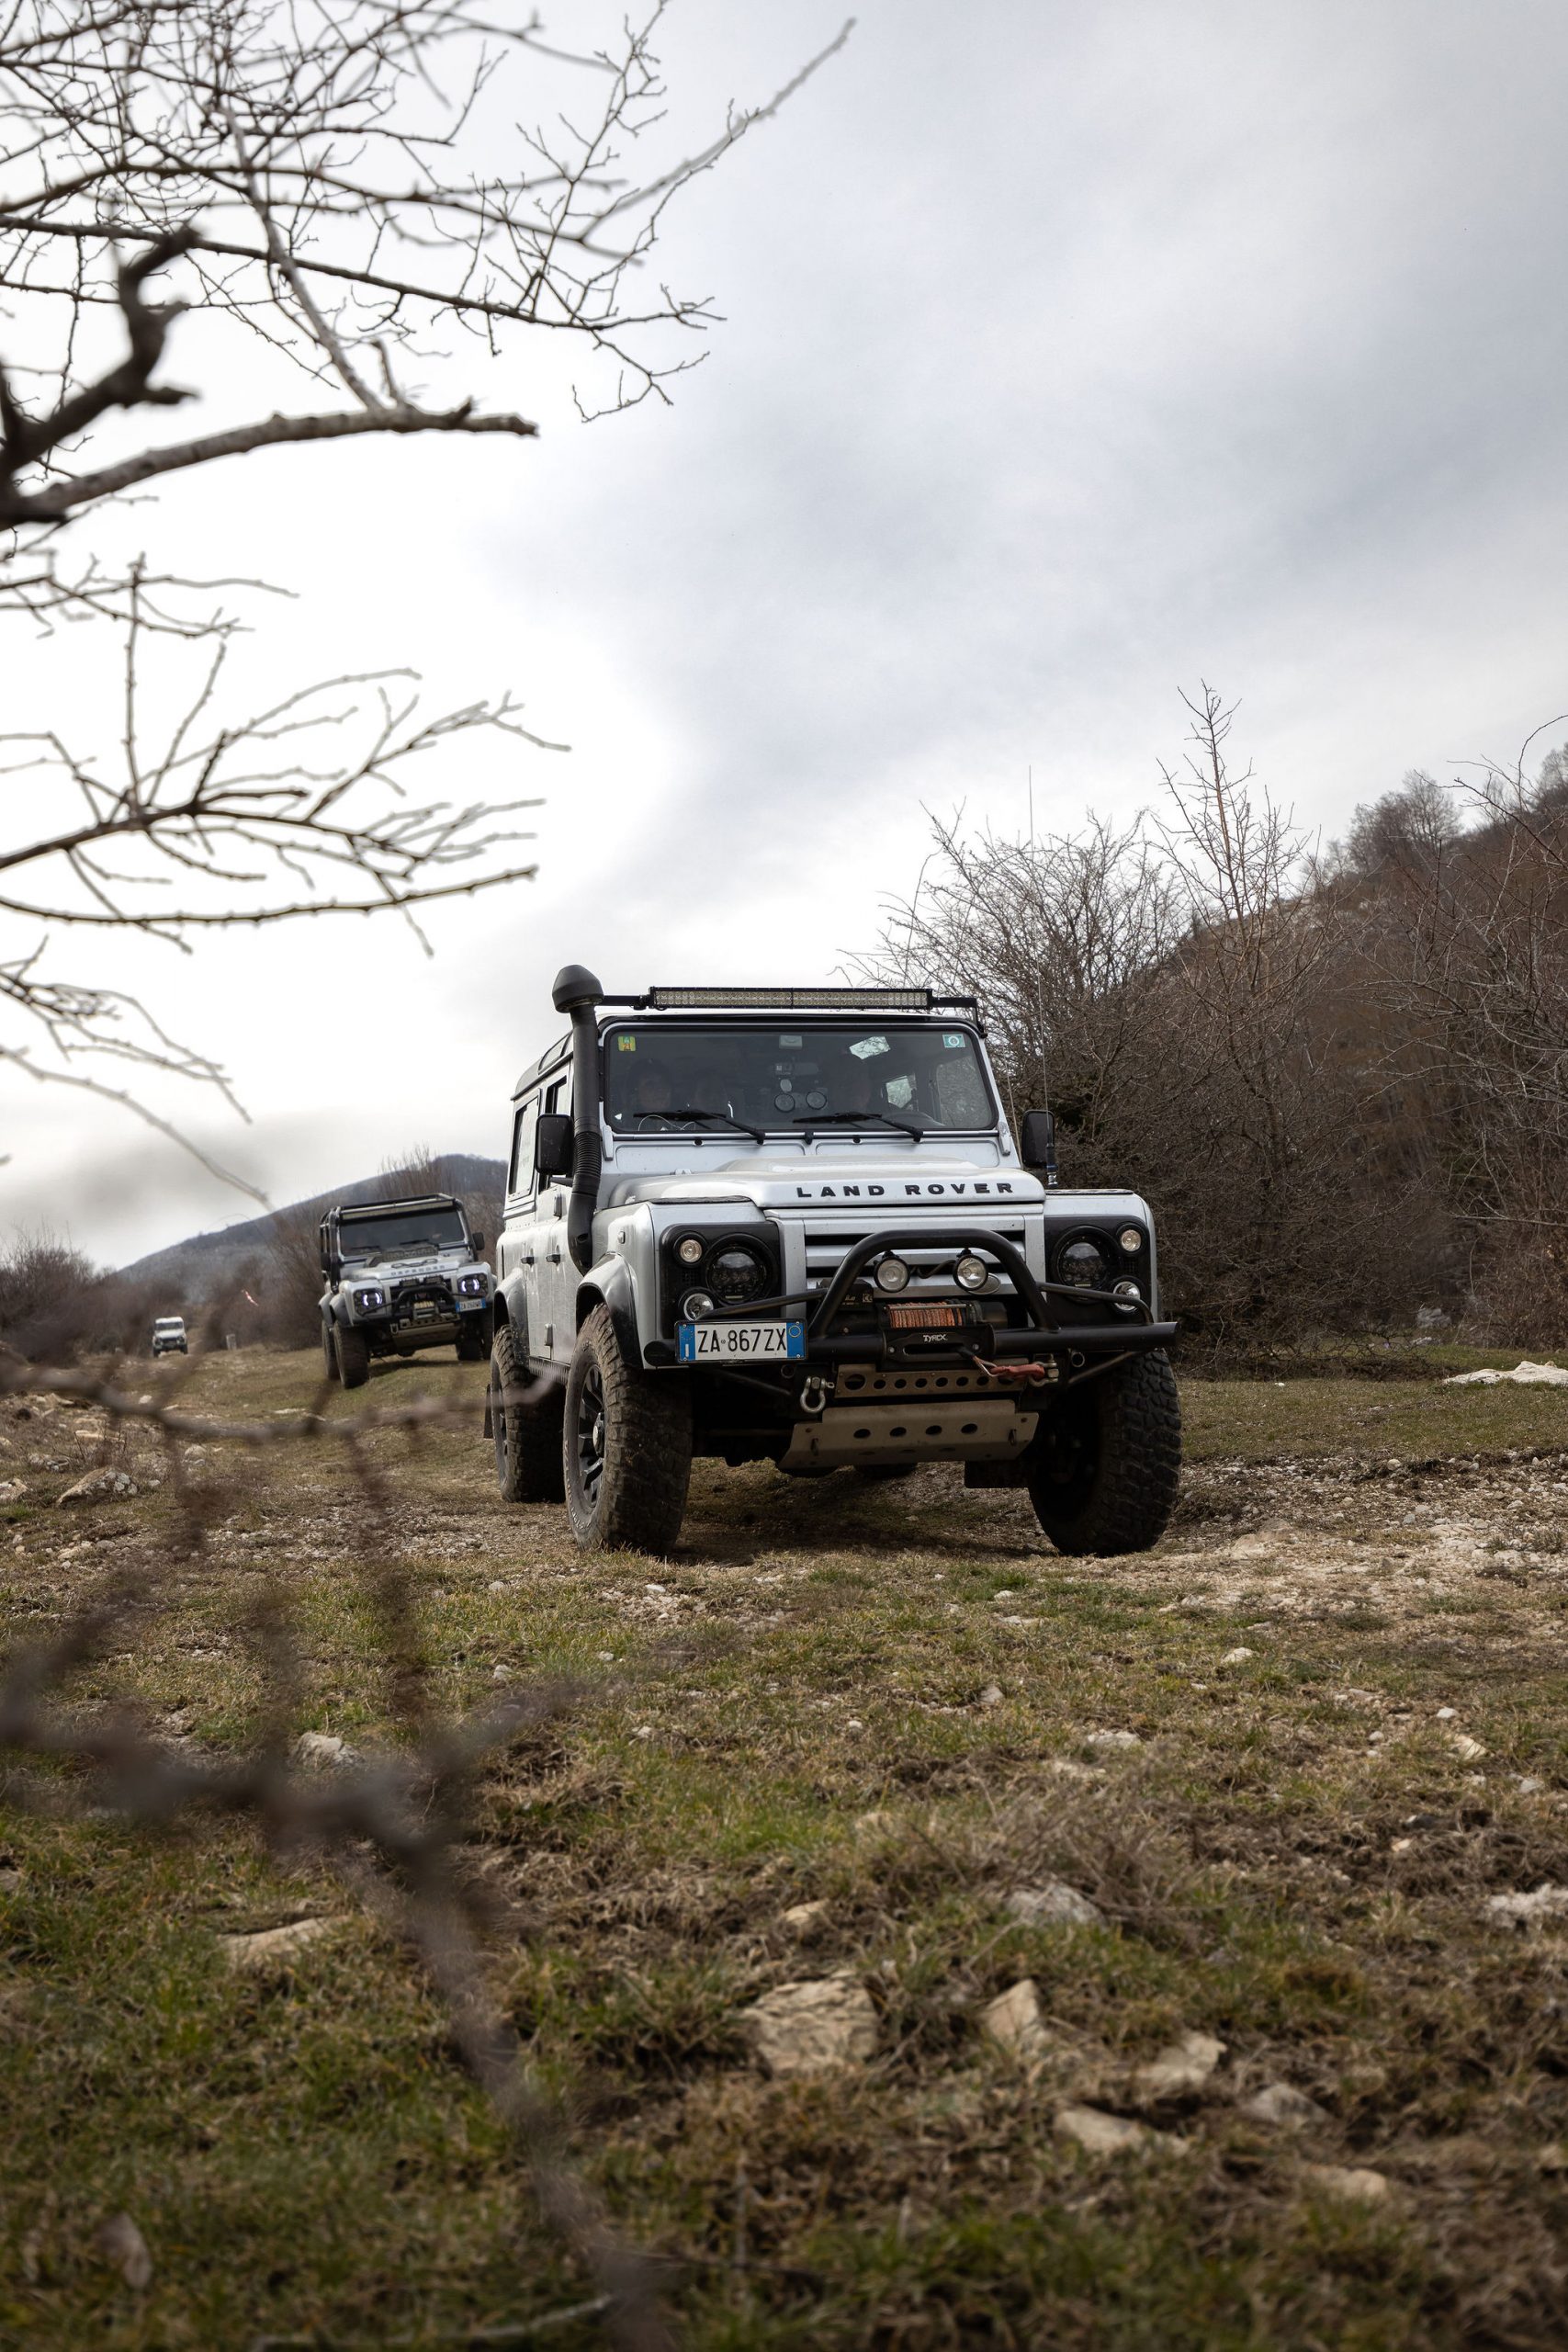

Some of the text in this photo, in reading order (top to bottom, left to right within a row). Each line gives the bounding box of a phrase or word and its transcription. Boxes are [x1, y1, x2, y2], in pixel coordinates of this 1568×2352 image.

[795, 1182, 1013, 1198] LAND ROVER
[697, 1329, 787, 1353] ZA 867ZX
[922, 1333, 947, 1343] TYREX
